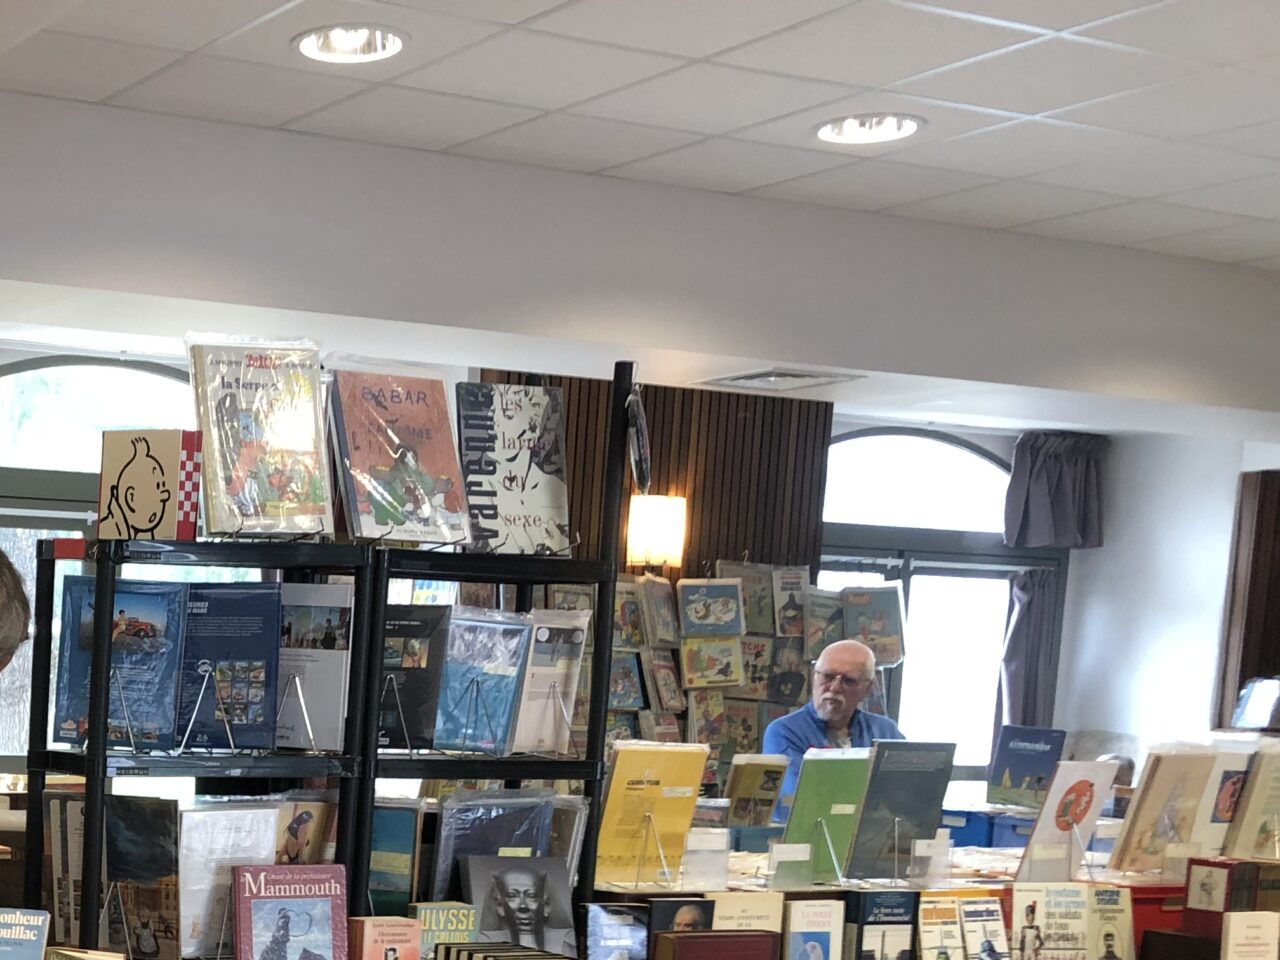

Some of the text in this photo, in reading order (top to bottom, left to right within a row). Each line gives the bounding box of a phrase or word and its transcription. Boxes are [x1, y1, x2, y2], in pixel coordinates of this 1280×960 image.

[361, 386, 427, 408] BABAR
[501, 397, 523, 412] les
[503, 470, 525, 489] du
[504, 515, 542, 529] sexe
[243, 872, 340, 896] Mammouth
[420, 909, 476, 930] ULYSSE
